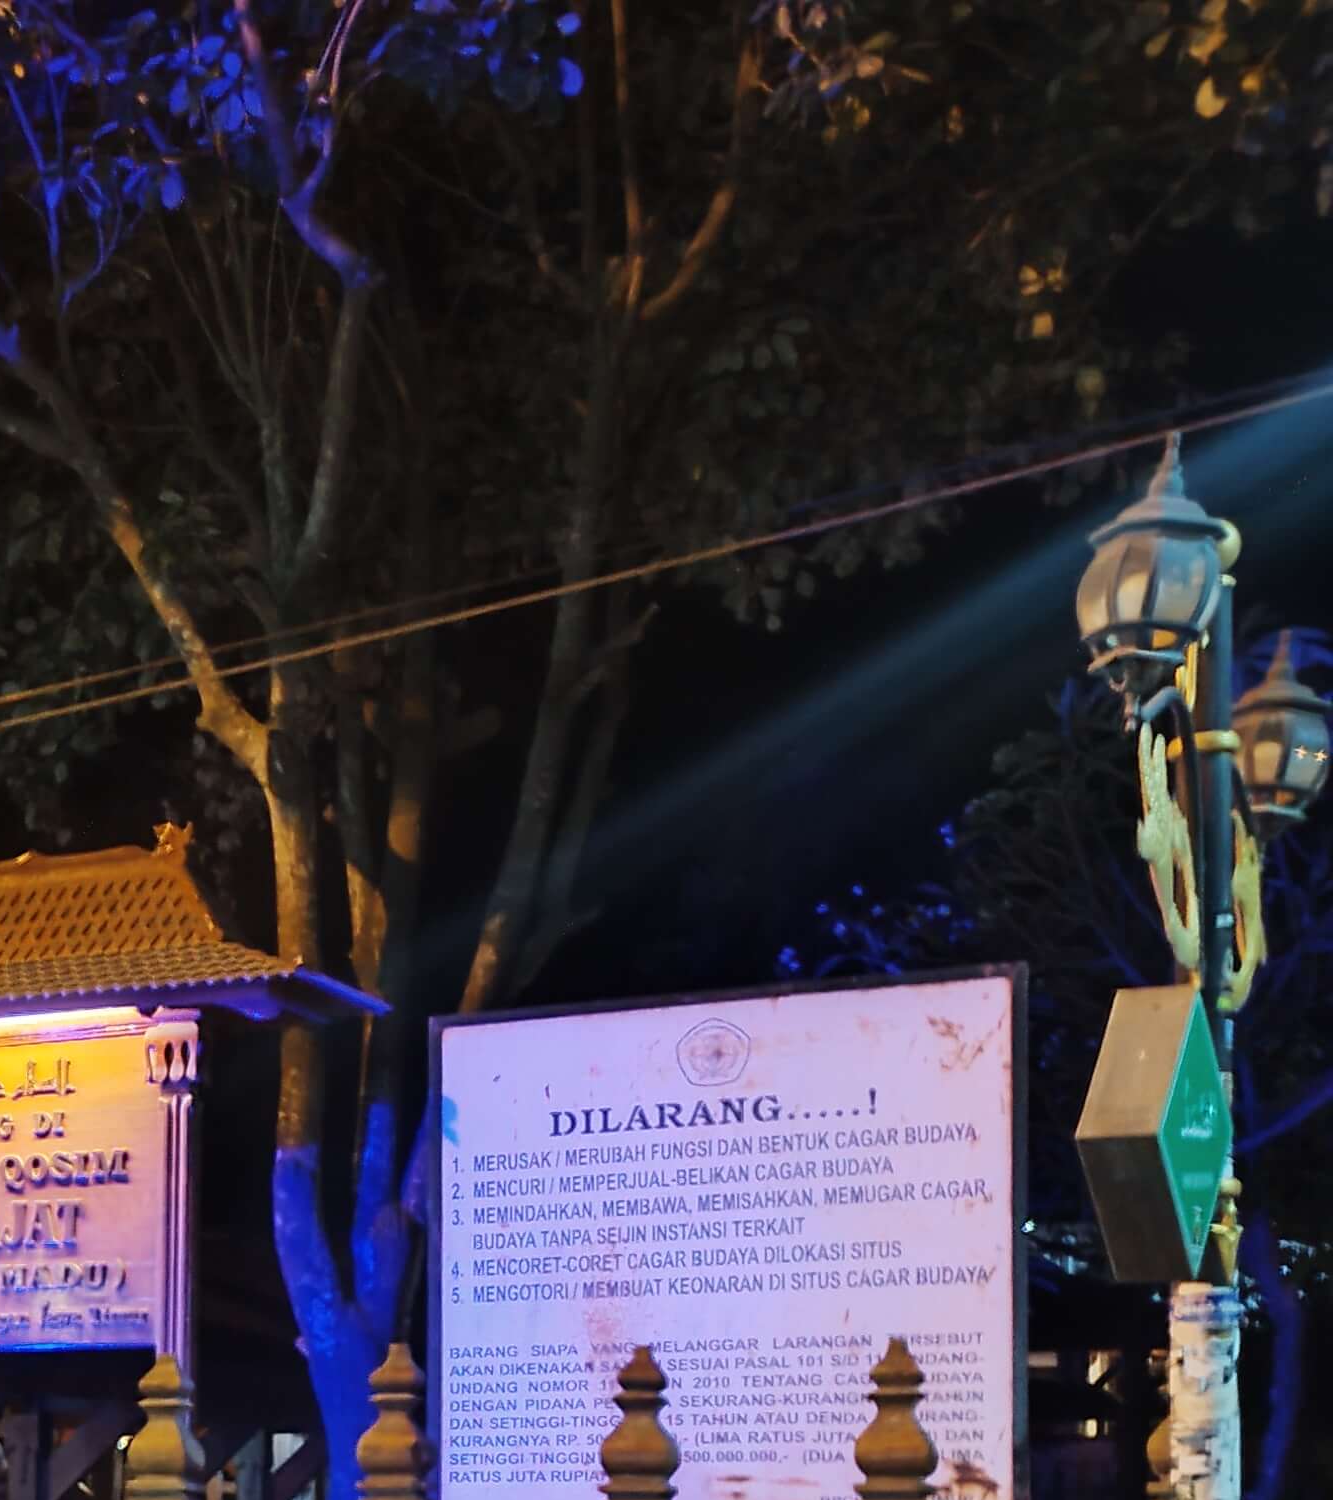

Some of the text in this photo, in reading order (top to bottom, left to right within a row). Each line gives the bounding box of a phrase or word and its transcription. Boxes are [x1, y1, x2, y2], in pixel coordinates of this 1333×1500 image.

[34, 1111, 67, 1140] DI
[452, 1156, 465, 1174] 1.
[473, 1150, 551, 1172] MERUSAK
[565, 1143, 646, 1168] MERUBAH
[651, 1139, 713, 1161] FUNGSI
[717, 1136, 753, 1157] DAN
[758, 1130, 830, 1153] BENTUK
[835, 1127, 899, 1150] CAGAR
[904, 1122, 978, 1145] BUDAYA
[0, 1148, 130, 1194] QOSIM
[451, 1183, 465, 1200] 2.
[473, 1176, 545, 1199] MENCURI
[559, 1163, 750, 1194] MEMPERJUAL-BELIKAN
[755, 1160, 817, 1182] CAGAR
[823, 1155, 894, 1178] BUDAYA
[451, 1208, 465, 1226] 3.
[473, 1202, 597, 1225] MEMINDAHKAN,
[602, 1196, 692, 1219] MEMBAWA,
[823, 1182, 915, 1206] MEMUGAR
[473, 1216, 806, 1250] BUDAYA TANPA SEIJIN INSTANSI TERKAIT
[451, 1239, 902, 1280] 4. MENCORET-CORET CAGAR BUDAYA DILOKASI SITUS
[473, 1282, 570, 1304] MENGOTORI
[582, 1277, 663, 1300] MEMBUAT
[668, 1273, 764, 1296] KEONARAN
[769, 1272, 785, 1291] DI
[790, 1270, 841, 1290] SITUS
[846, 1266, 910, 1288] CAGAR
[916, 1264, 989, 1287] BUDAYA
[449, 1345, 518, 1360] BARANG
[532, 1343, 578, 1358] SIAPA
[591, 1341, 635, 1355] YANG
[647, 1338, 759, 1354] MELANGGAR
[773, 1334, 873, 1350] LARANGAN
[450, 1363, 494, 1377] AKAN
[499, 1360, 594, 1376] DIKENAKAN
[667, 1357, 730, 1372] SESUAI
[735, 1355, 790, 1370] PASAL
[798, 1354, 823, 1368] 101
[830, 1352, 860, 1367] S/D
[916, 1350, 985, 1365] NDANG-
[450, 1380, 518, 1395] UNDANG
[528, 1379, 589, 1393] NOMOR
[693, 1377, 731, 1391] 2010
[742, 1373, 823, 1388] TENTANG
[450, 1398, 517, 1413] DENGAN
[525, 1397, 586, 1412] PIDANA
[450, 1416, 482, 1431] DAN
[667, 1413, 684, 1427] 15
[692, 1411, 748, 1426] TAHUN
[754, 1410, 798, 1425] ATAU
[807, 1408, 869, 1424] DENDA
[450, 1433, 550, 1449] KURANGNYA
[694, 1430, 741, 1446] (LIMA
[748, 1430, 804, 1444] RATUS
[813, 1428, 857, 1443] JUTA
[945, 1428, 984, 1441] DAN
[803, 1448, 846, 1465] (DUA
[449, 1469, 501, 1483] RATUS
[507, 1469, 546, 1483] JUTA
